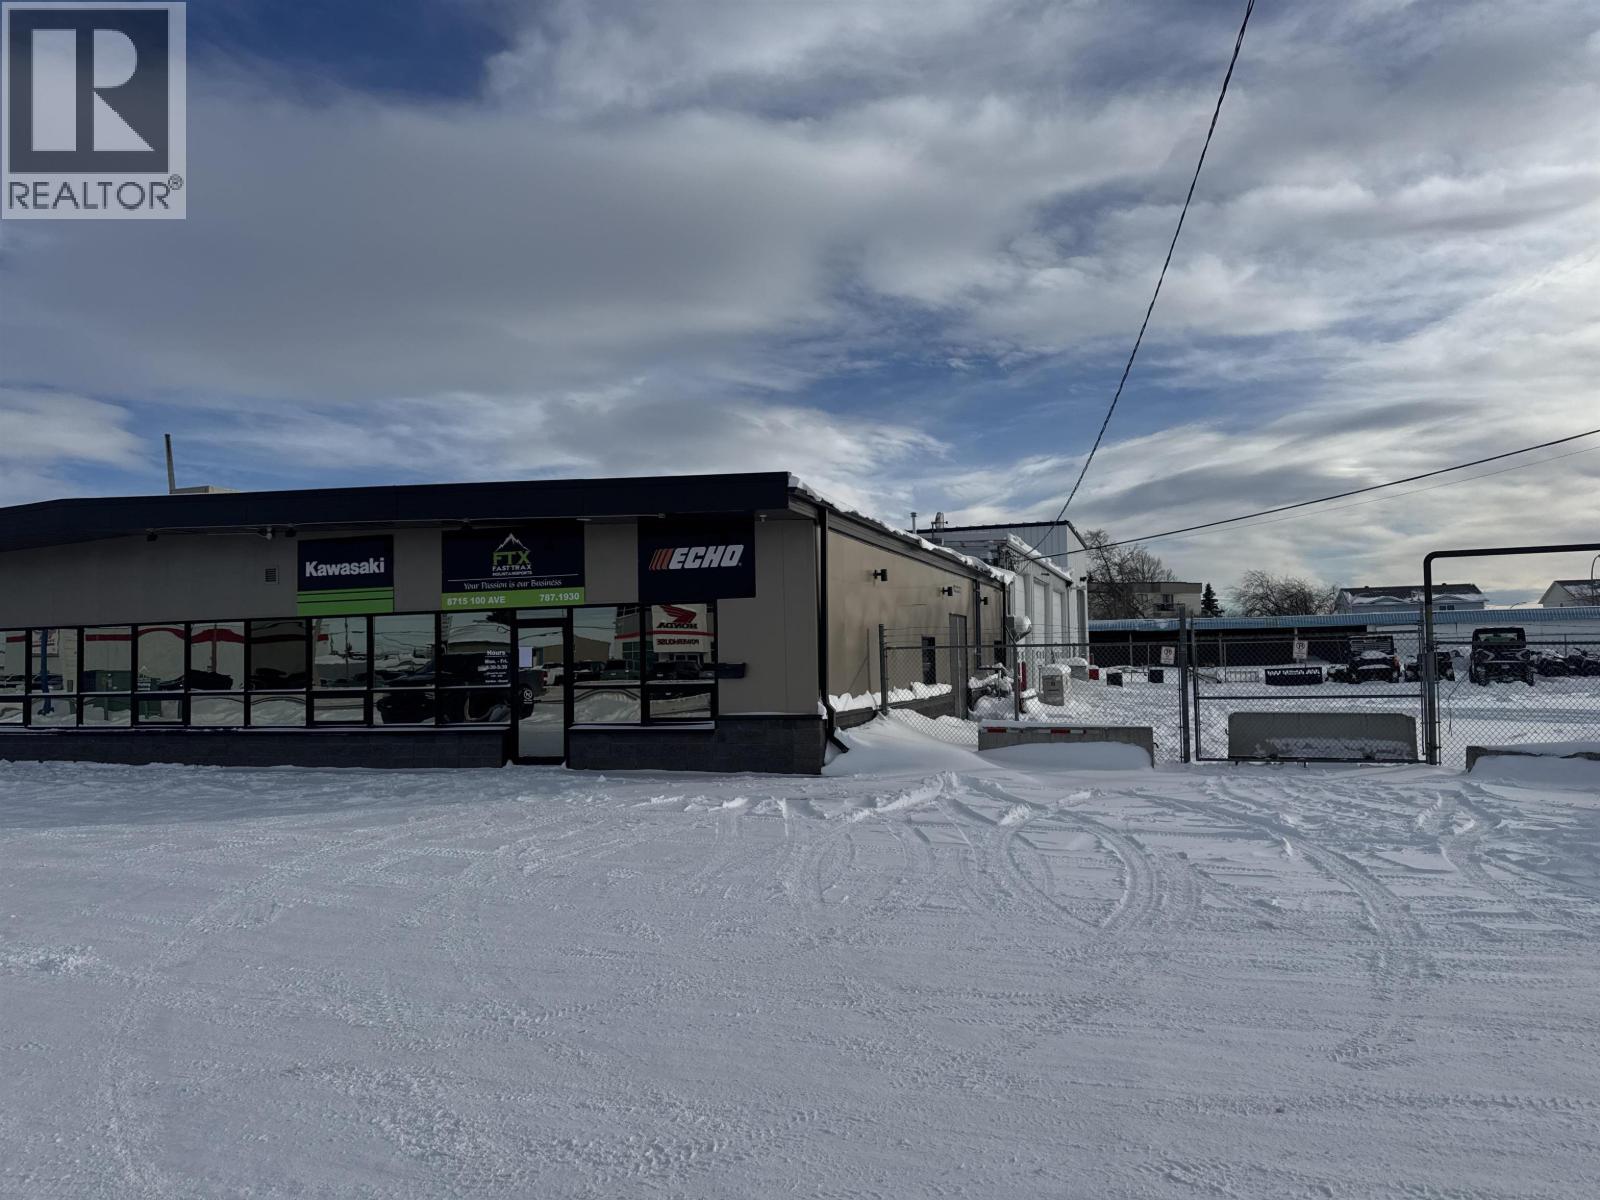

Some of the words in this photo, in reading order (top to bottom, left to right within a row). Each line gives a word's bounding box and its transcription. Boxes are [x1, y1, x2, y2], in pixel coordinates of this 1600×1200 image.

[493, 551, 529, 565] FTX
[668, 544, 745, 570] ECHO
[305, 557, 385, 577] Kawasaki
[464, 582, 480, 590] Your
[481, 581, 507, 589] Passion
[508, 580, 516, 588] is
[530, 579, 562, 587] Business
[447, 597, 469, 606] 8715
[470, 596, 486, 605] 100
[487, 595, 506, 604] AVE
[539, 592, 580, 602] 787.1930
